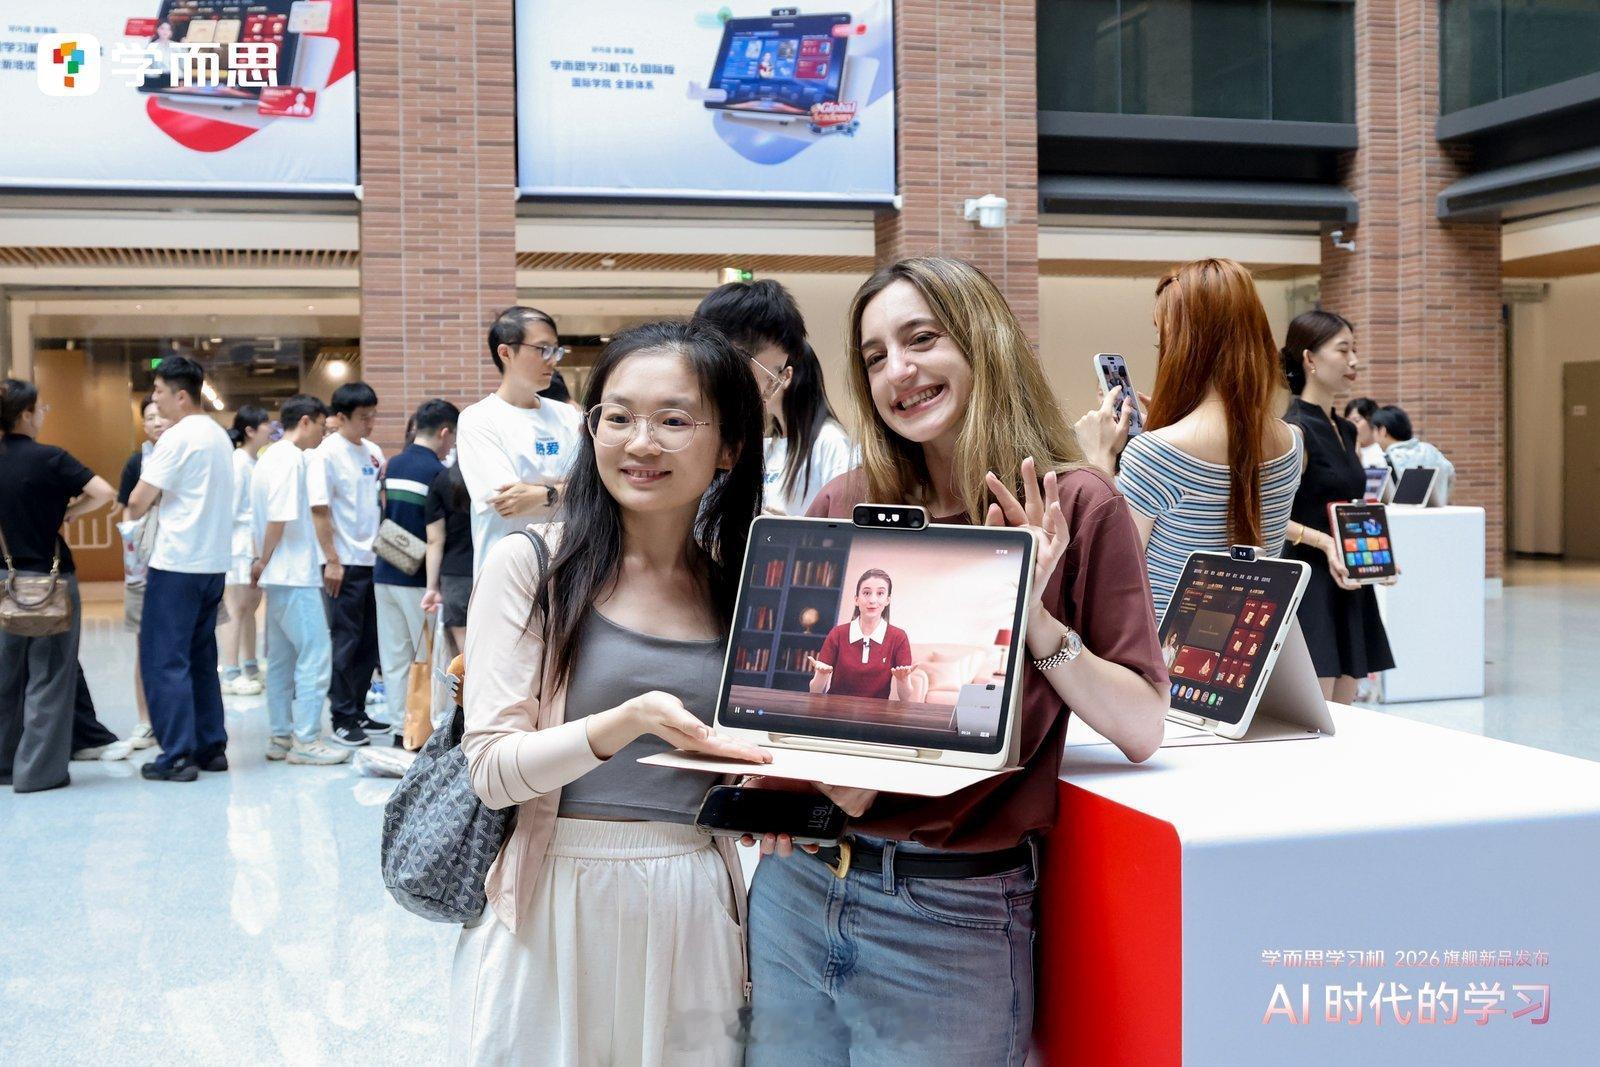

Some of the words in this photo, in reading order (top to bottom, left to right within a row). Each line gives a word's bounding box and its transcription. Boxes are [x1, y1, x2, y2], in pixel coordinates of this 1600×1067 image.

[0, 59, 36, 70] 新培优
[550, 60, 620, 73] 学而思学习机
[622, 62, 639, 73] T6
